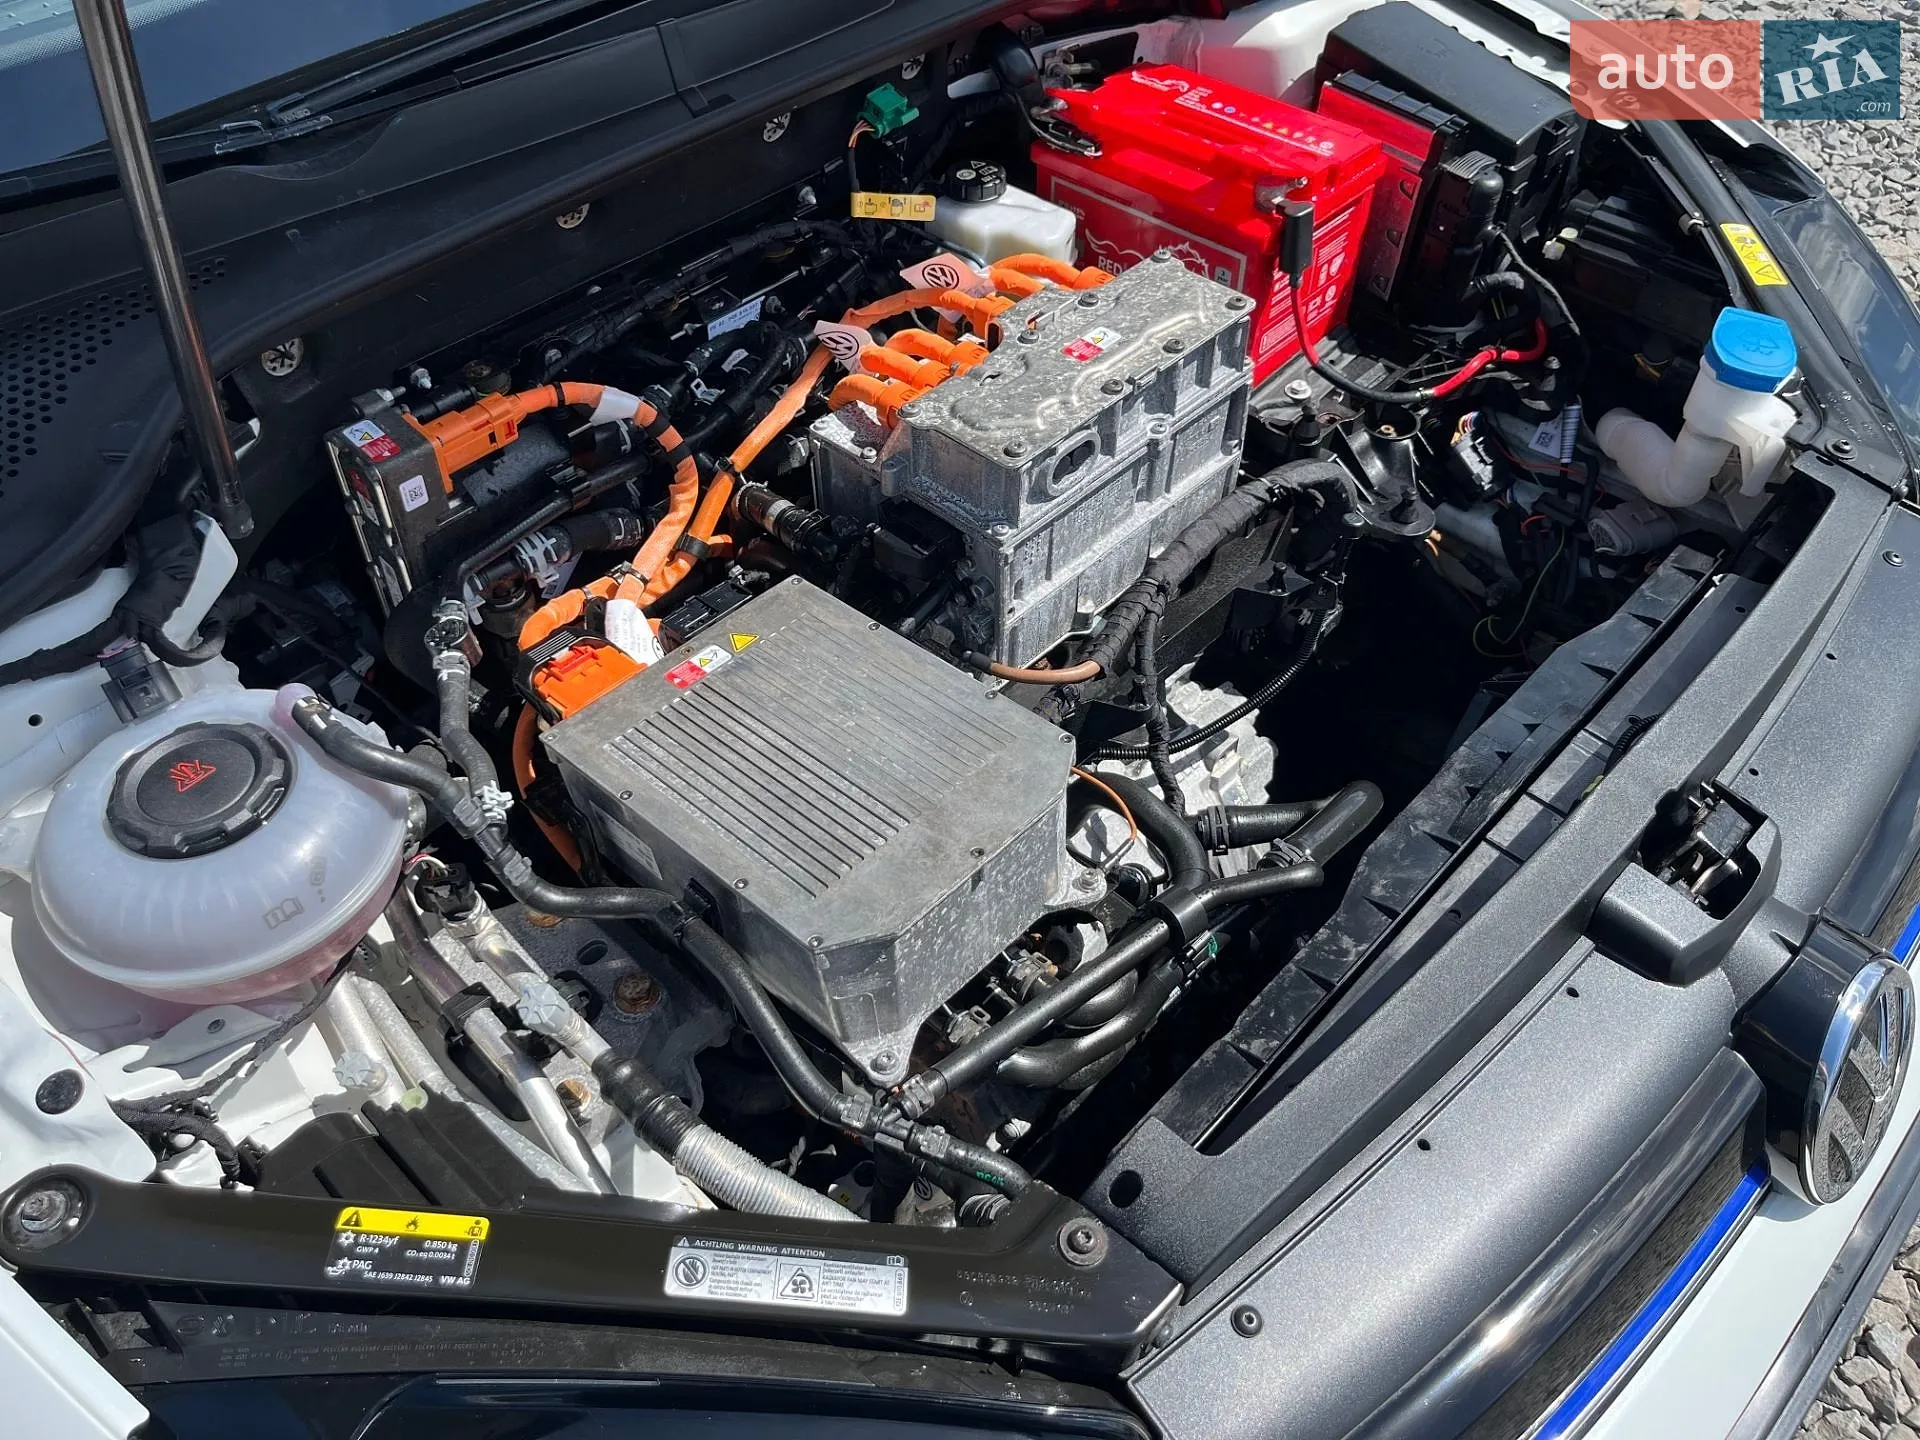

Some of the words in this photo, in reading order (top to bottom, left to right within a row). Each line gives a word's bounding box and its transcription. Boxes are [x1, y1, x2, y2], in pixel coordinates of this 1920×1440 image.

[1098, 255, 1123, 276] RED
[359, 1234, 400, 1249] R-1234yf
[425, 1240, 447, 1250] 0.850
[447, 1242, 458, 1252] kg
[694, 1239, 734, 1250] ACHTUNG
[738, 1243, 778, 1254] WARNING
[781, 1248, 825, 1258] ATTENTION
[352, 1260, 373, 1270] PAG
[363, 1271, 376, 1279] SAE
[441, 1275, 456, 1284] VW
[458, 1276, 471, 1285] AG
